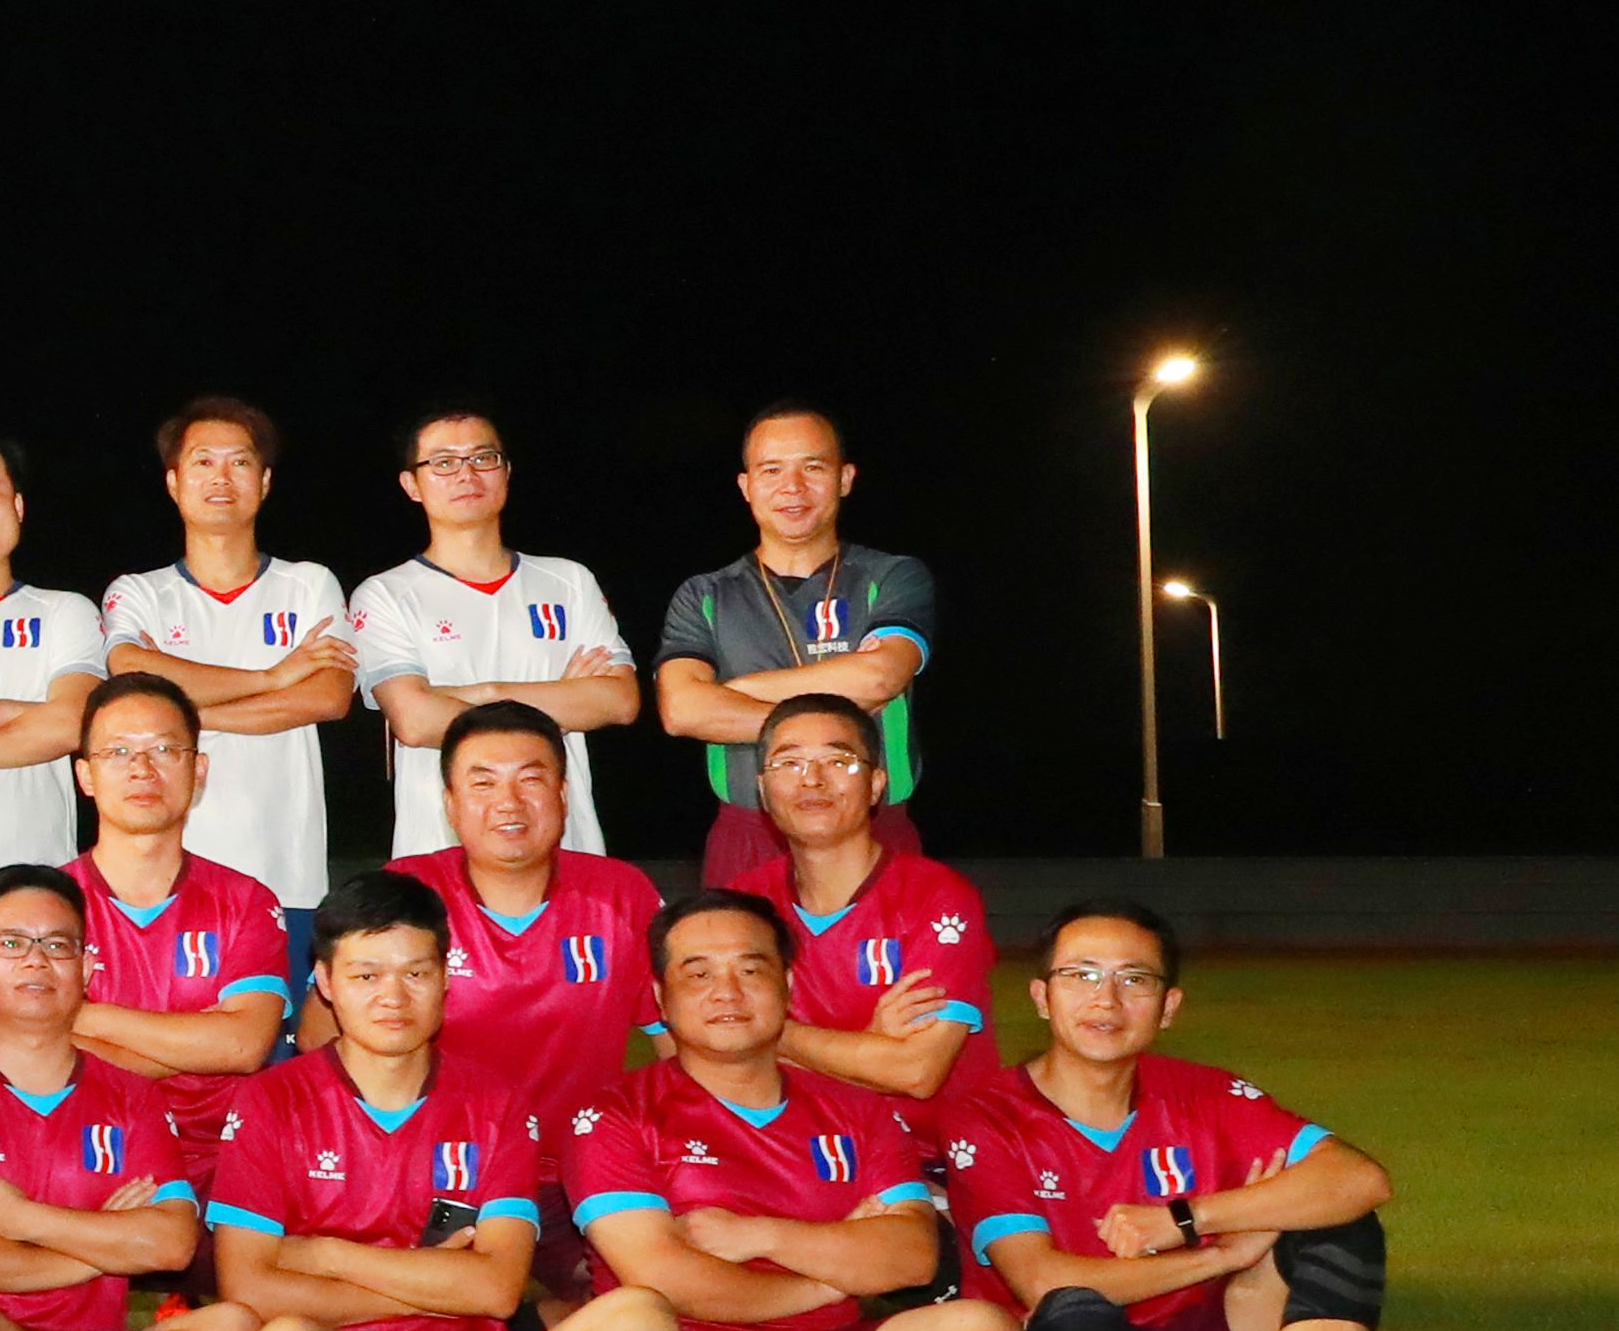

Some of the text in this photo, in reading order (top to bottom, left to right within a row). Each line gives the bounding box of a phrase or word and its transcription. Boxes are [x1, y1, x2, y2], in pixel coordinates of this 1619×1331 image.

[681, 1155, 718, 1165] KELME
[309, 1170, 346, 1181] KELME
[1033, 1189, 1066, 1200] KELME
